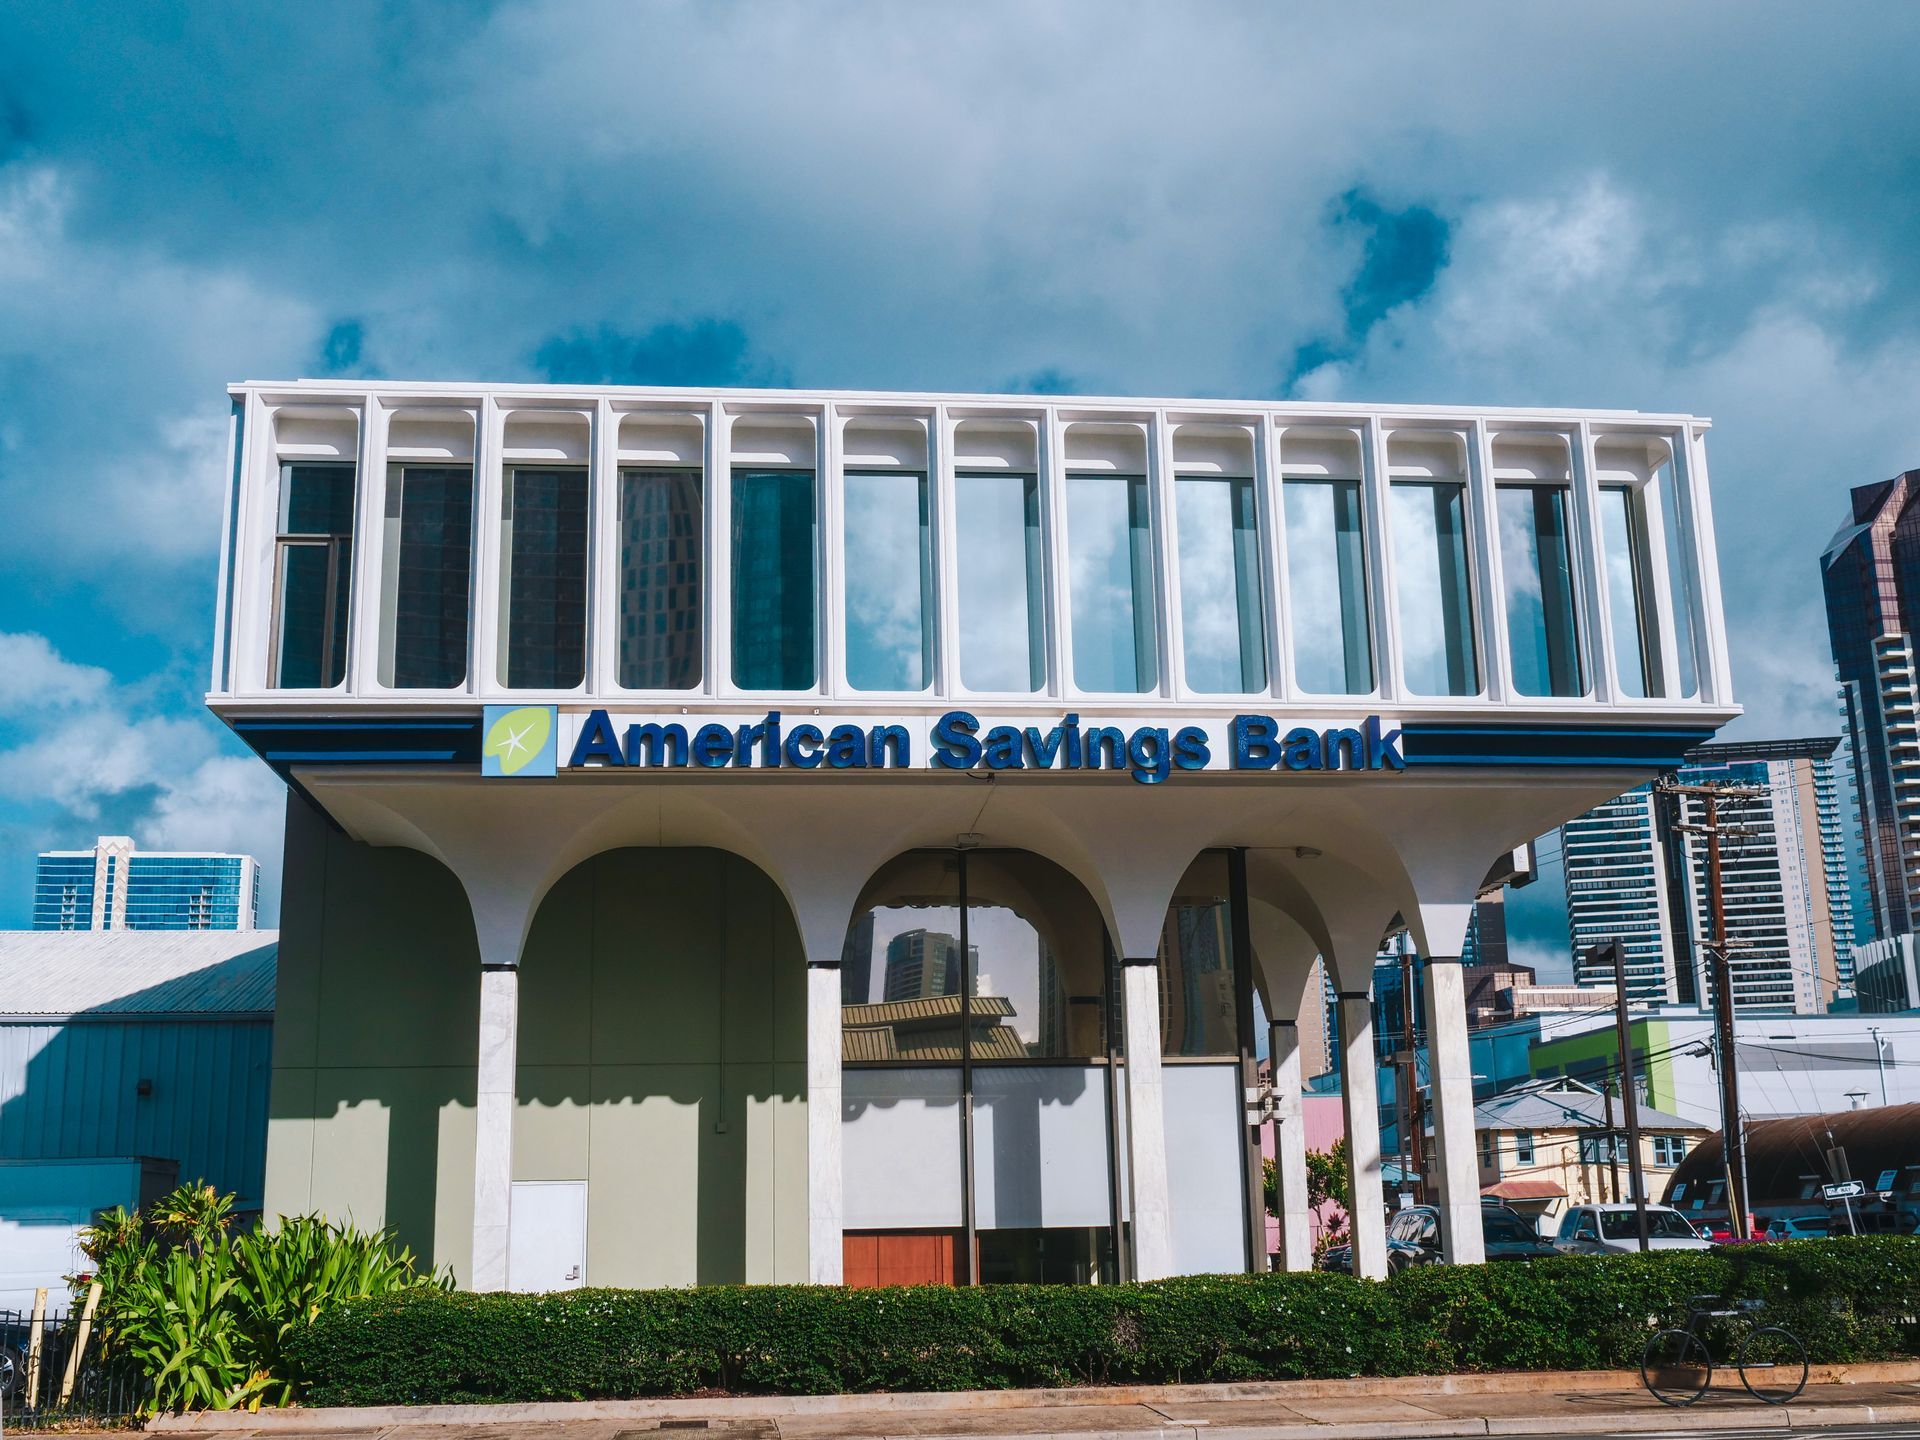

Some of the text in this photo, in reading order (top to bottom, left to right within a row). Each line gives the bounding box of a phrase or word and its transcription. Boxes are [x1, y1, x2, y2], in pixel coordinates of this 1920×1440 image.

[571, 709, 1406, 784] American Savings Bank
